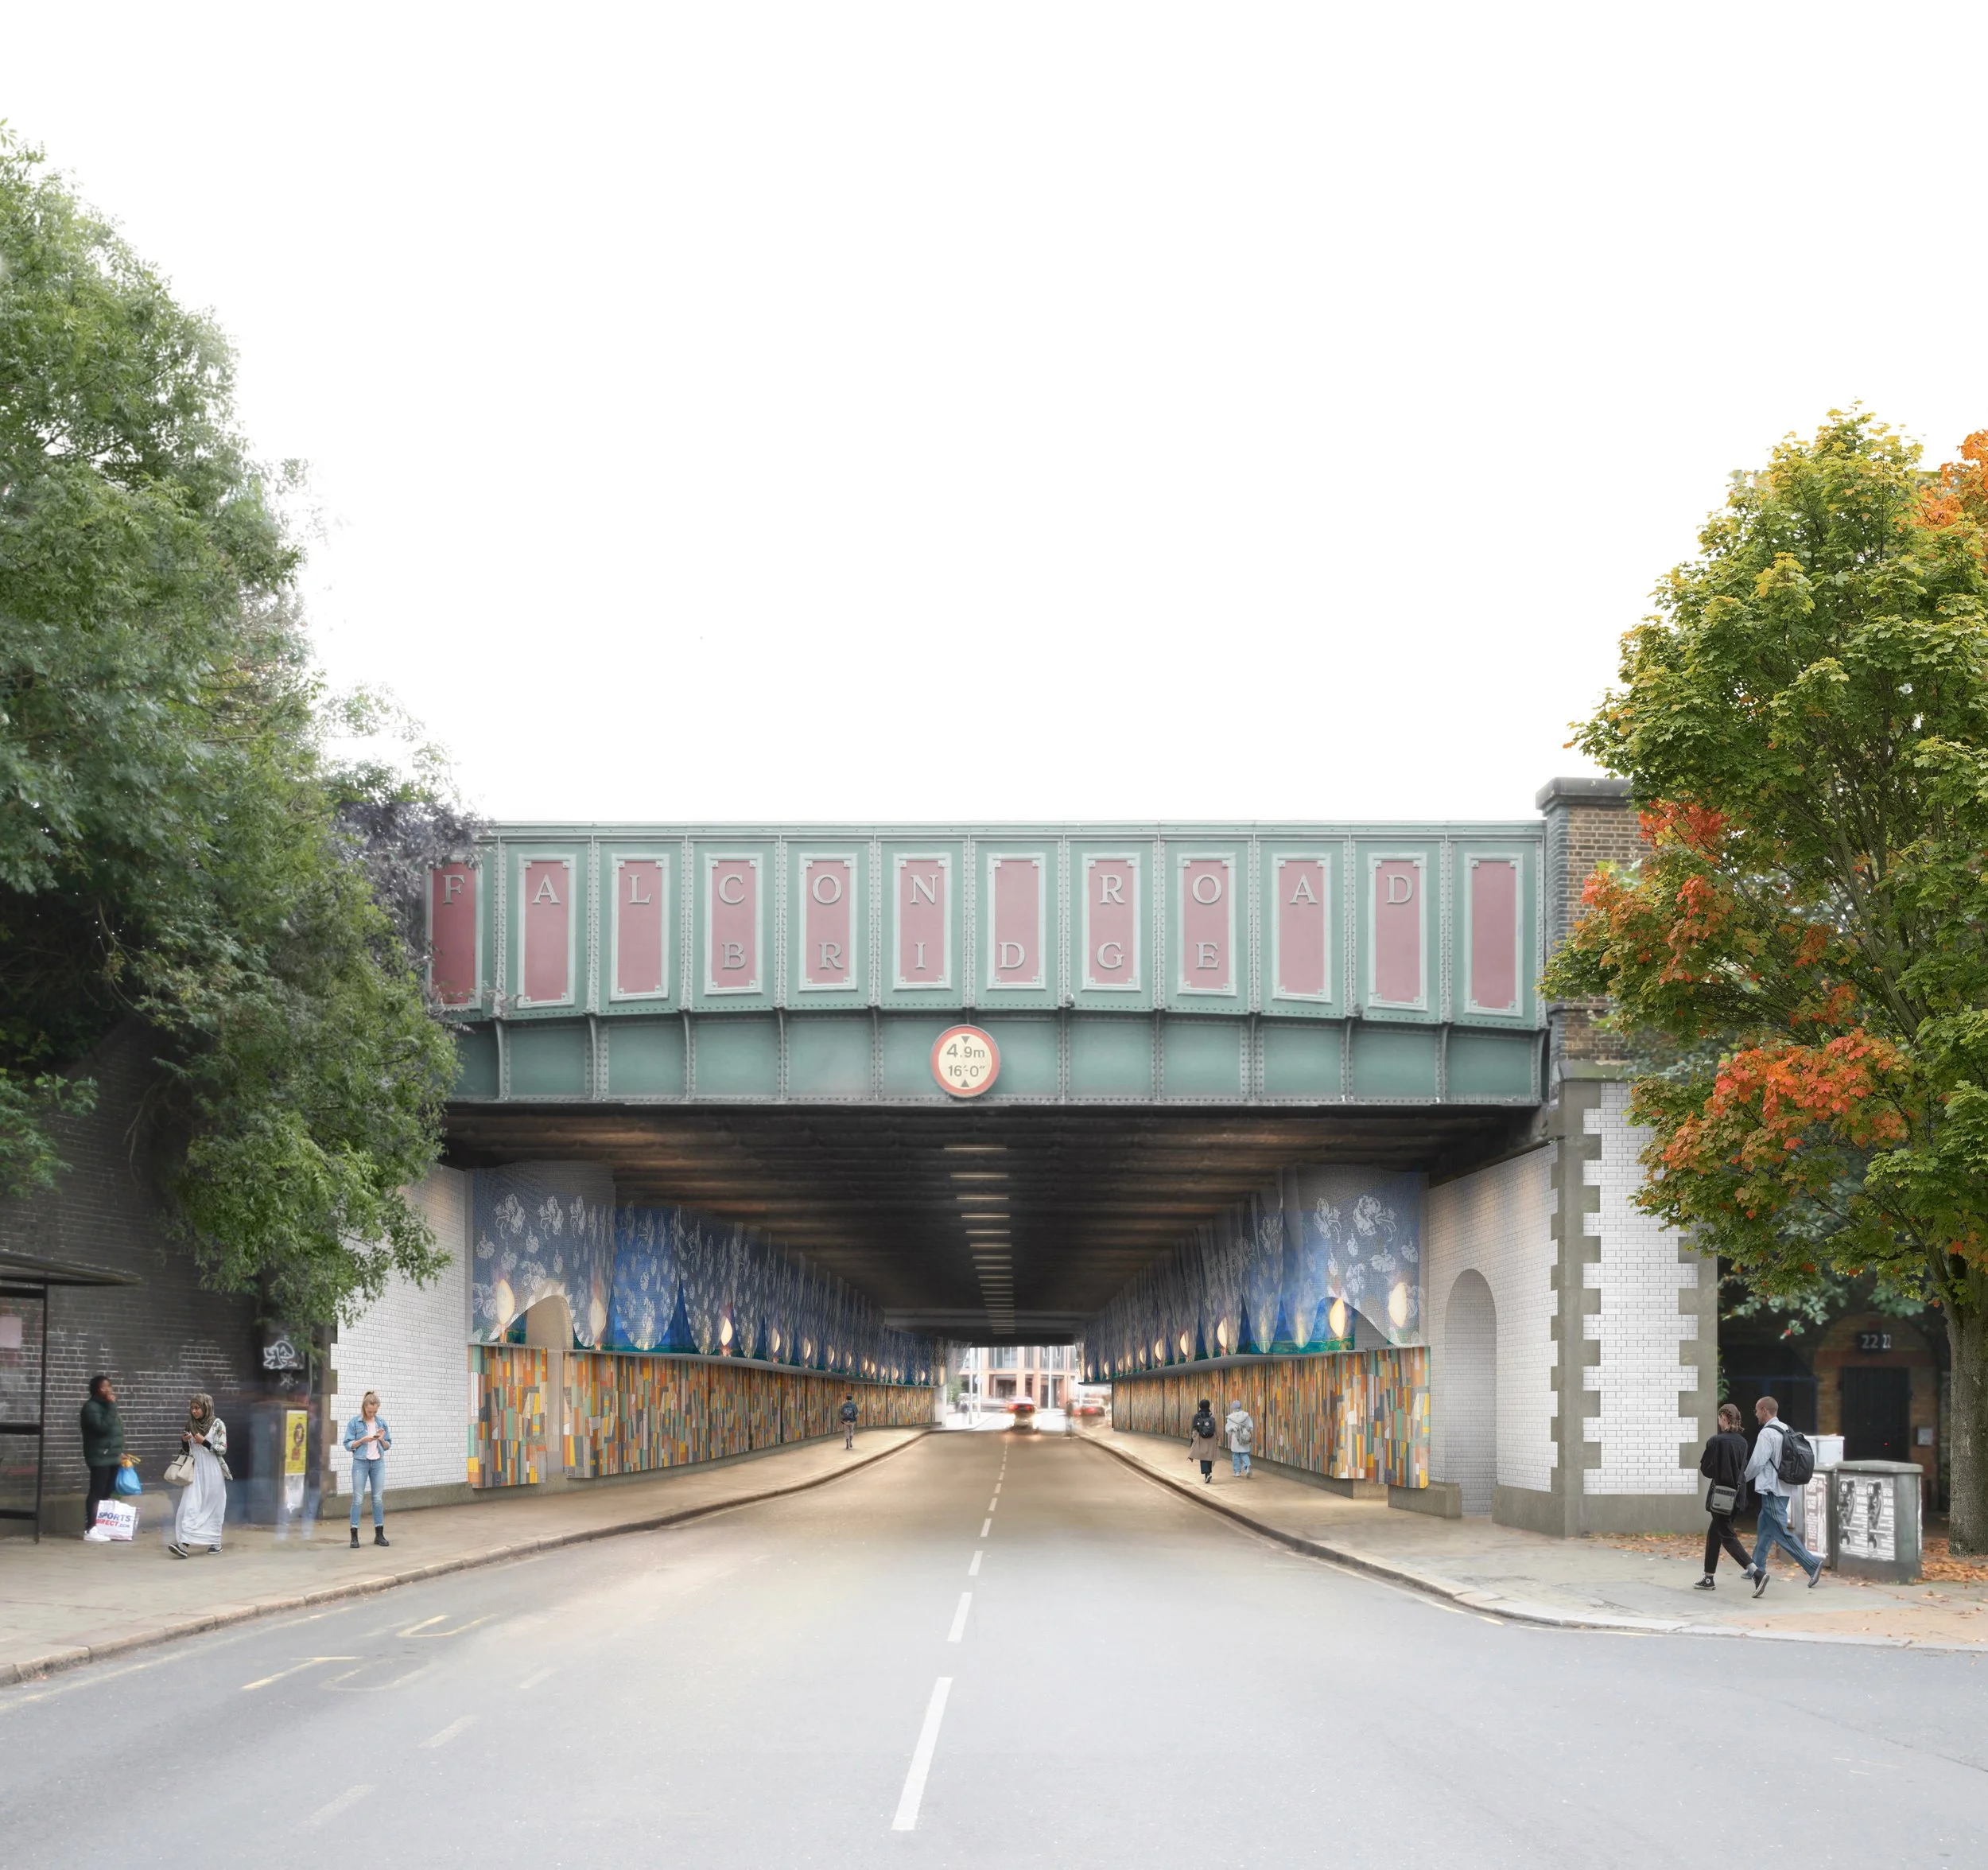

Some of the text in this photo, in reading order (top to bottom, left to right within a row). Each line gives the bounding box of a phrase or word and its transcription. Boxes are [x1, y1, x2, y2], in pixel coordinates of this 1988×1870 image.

[443, 873, 1414, 905] FALCON ROAD
[722, 942, 1221, 970] BRIDGE
[946, 1044, 985, 1058] 4.9m
[1862, 1334, 1878, 1349] 22
[98, 1512, 131, 1522] SPORTS
